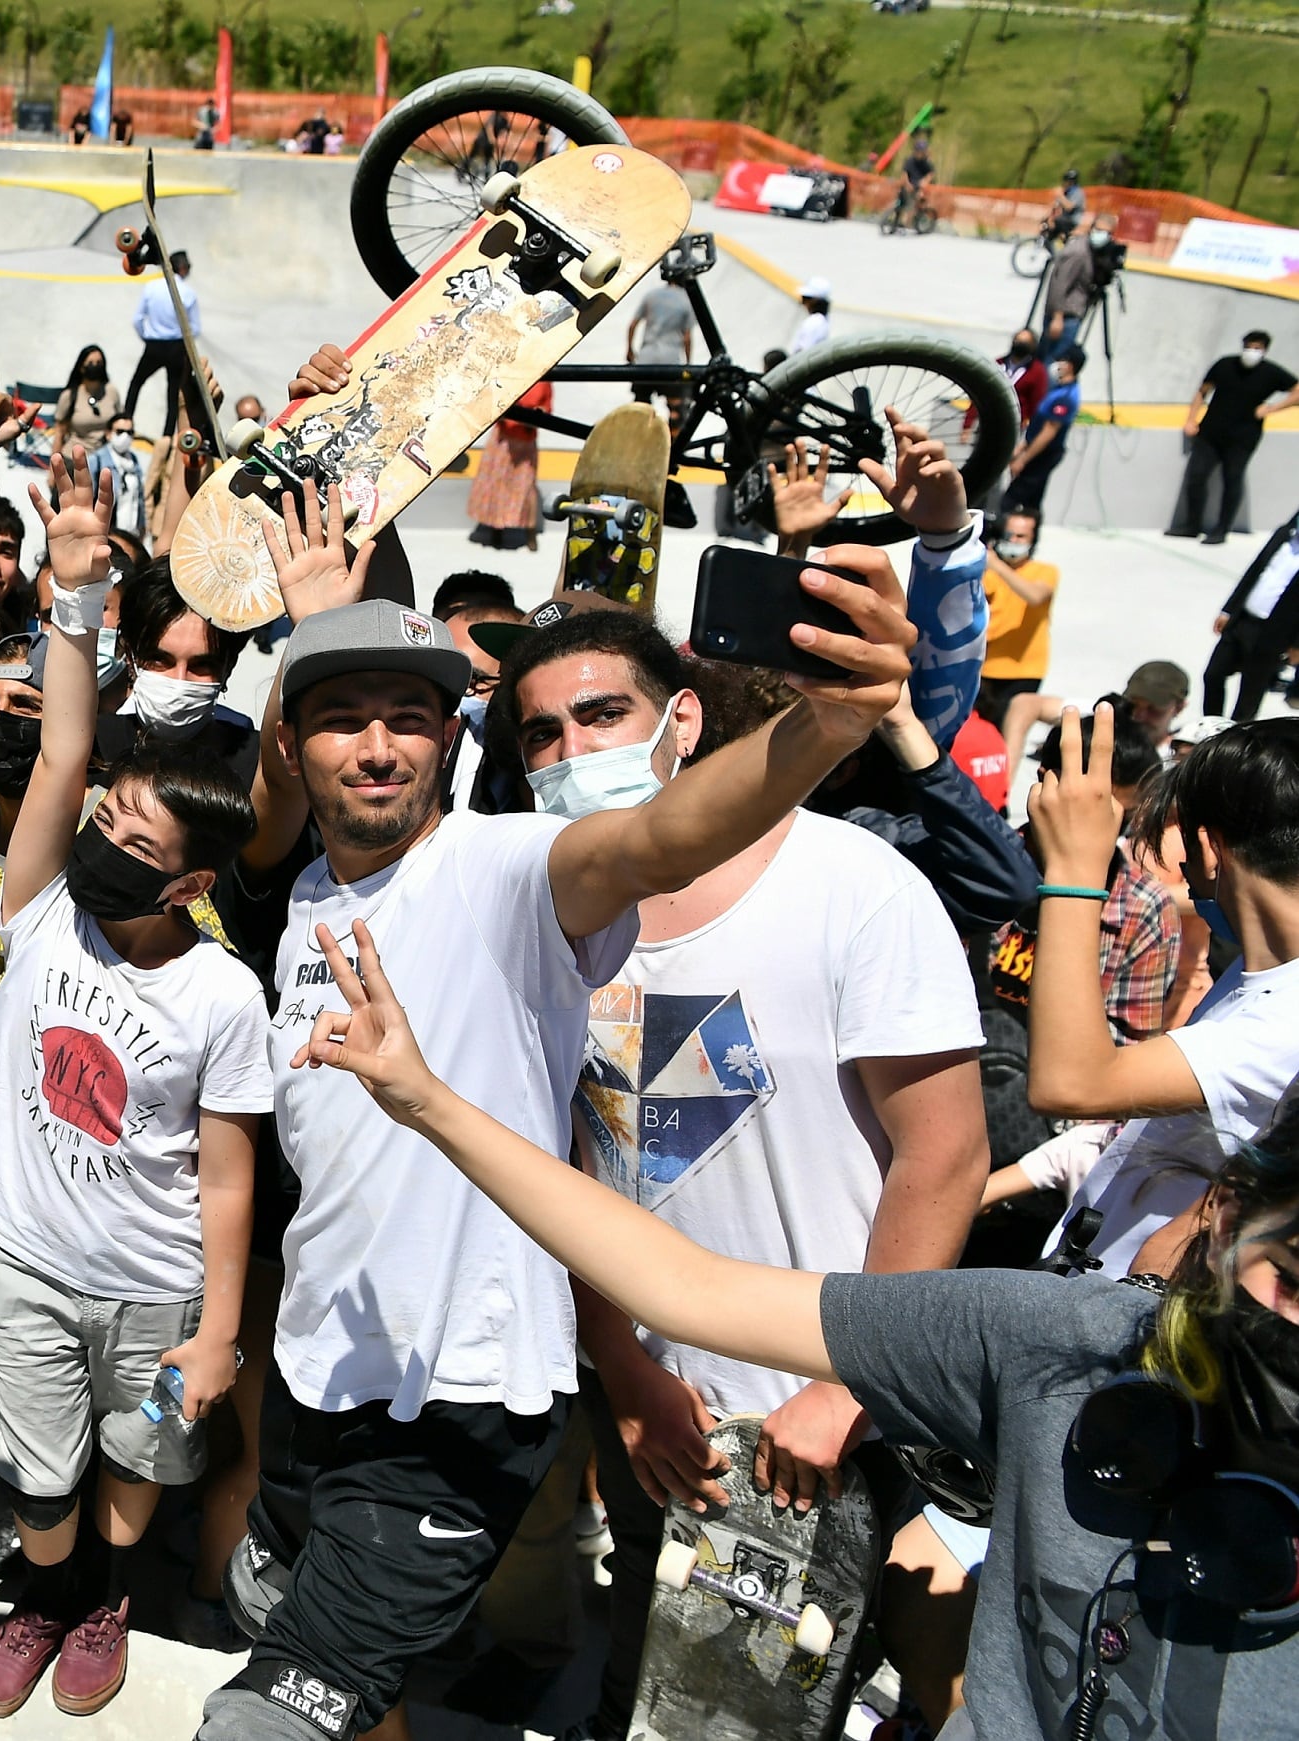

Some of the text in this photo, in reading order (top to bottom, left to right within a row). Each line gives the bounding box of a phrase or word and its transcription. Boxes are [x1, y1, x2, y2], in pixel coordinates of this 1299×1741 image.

[45, 968, 173, 1075] FREESTYLE
[50, 1045, 106, 1106] NYC
[70, 1153, 136, 1184] PARK
[269, 1684, 343, 1733] KILLER PADS
[280, 1669, 348, 1716] 187
